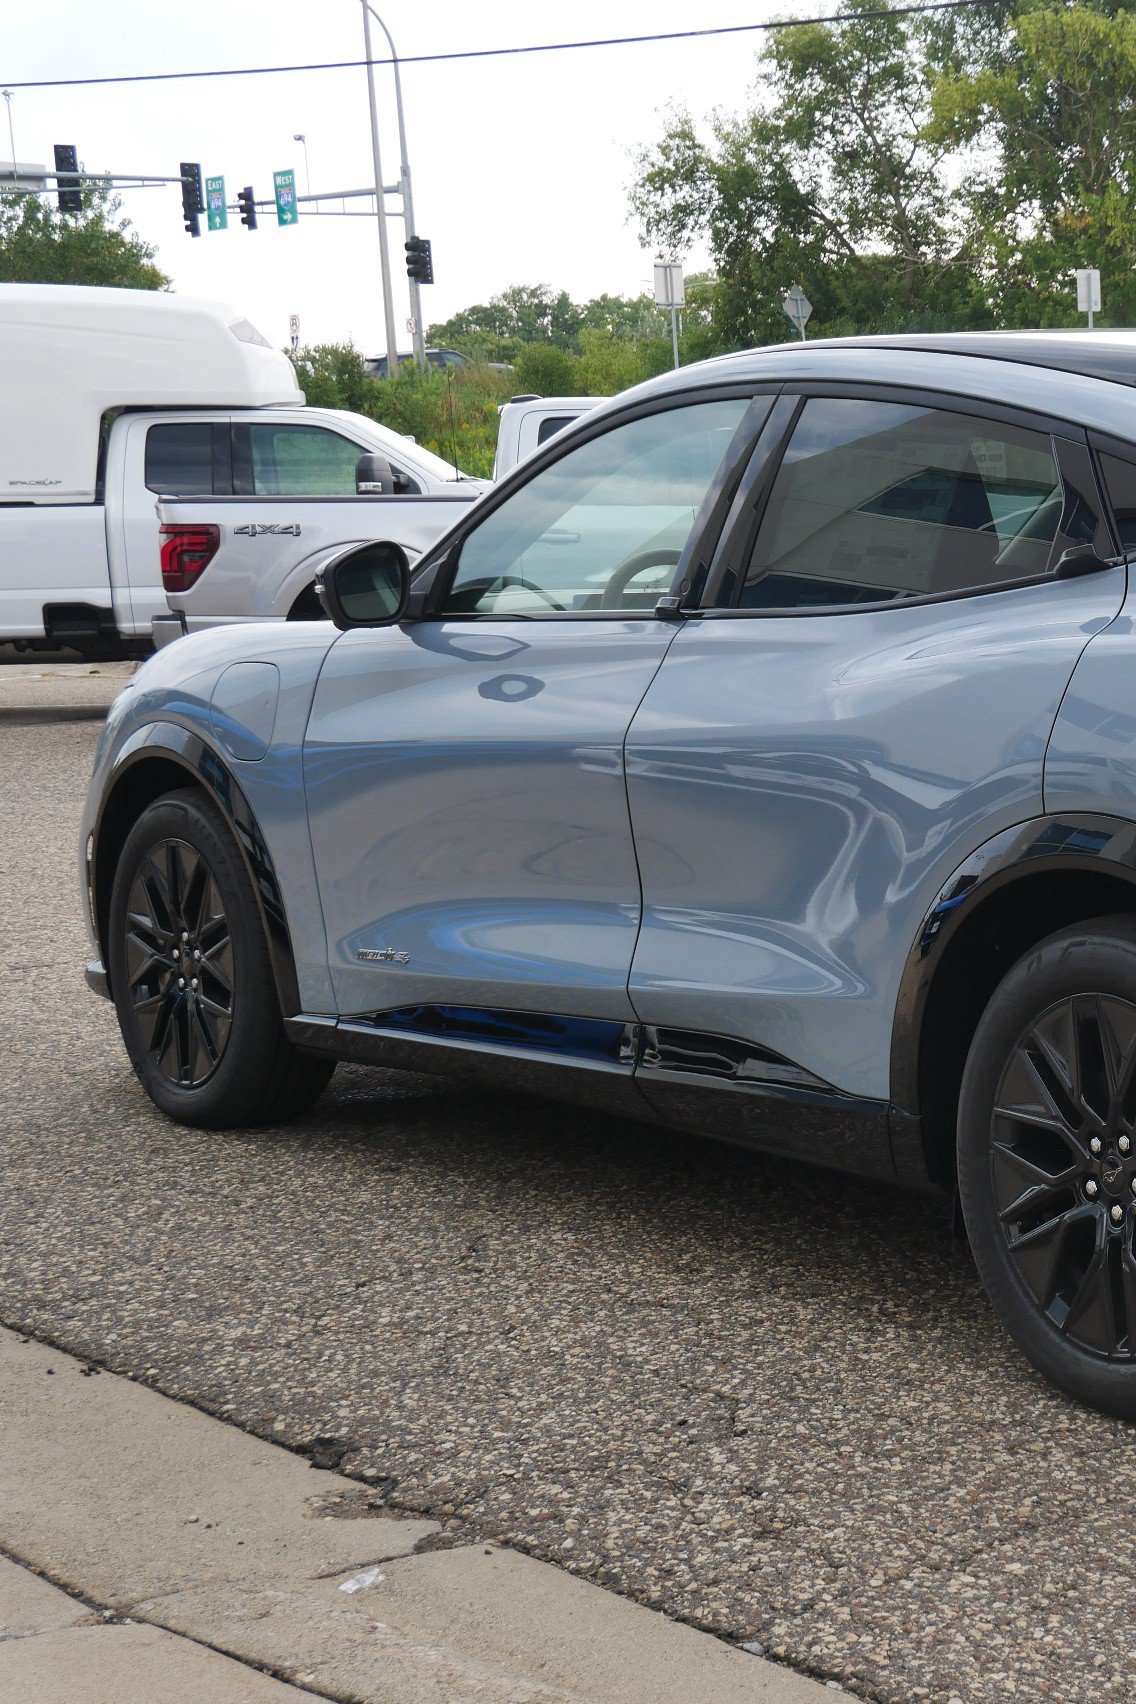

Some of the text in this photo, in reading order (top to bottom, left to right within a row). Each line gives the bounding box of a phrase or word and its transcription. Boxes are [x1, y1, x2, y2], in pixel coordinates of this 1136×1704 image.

[275, 175, 292, 185] WEST
[207, 181, 222, 190] EAST
[211, 198, 222, 209] 694
[280, 193, 292, 204] 694
